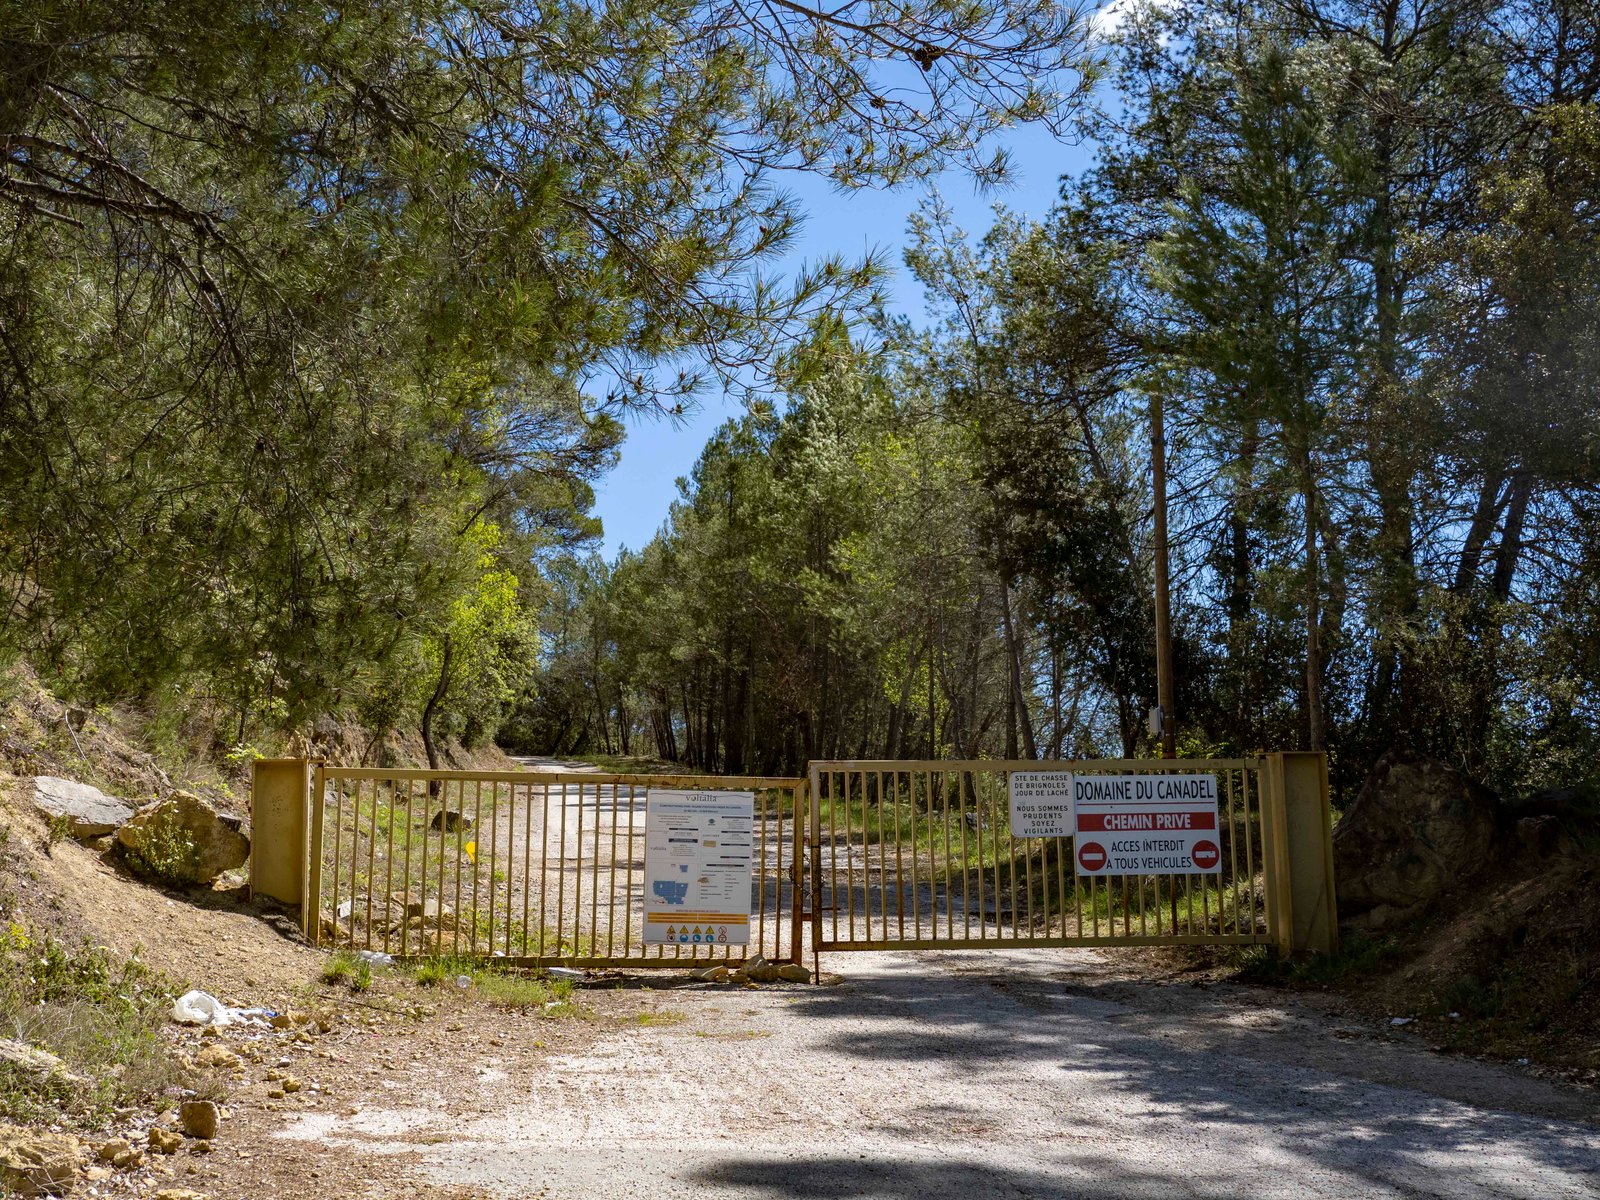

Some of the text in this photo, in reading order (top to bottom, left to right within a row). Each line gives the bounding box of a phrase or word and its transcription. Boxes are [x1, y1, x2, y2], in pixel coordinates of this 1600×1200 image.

[1075, 780, 1214, 800] DOMAINE DU CANADEL
[1103, 813, 1191, 830] CHEMIN PRIVE
[1111, 839, 1185, 853] ACCES INTERDIT
[1106, 856, 1192, 870] A TOUS VEHICULES
